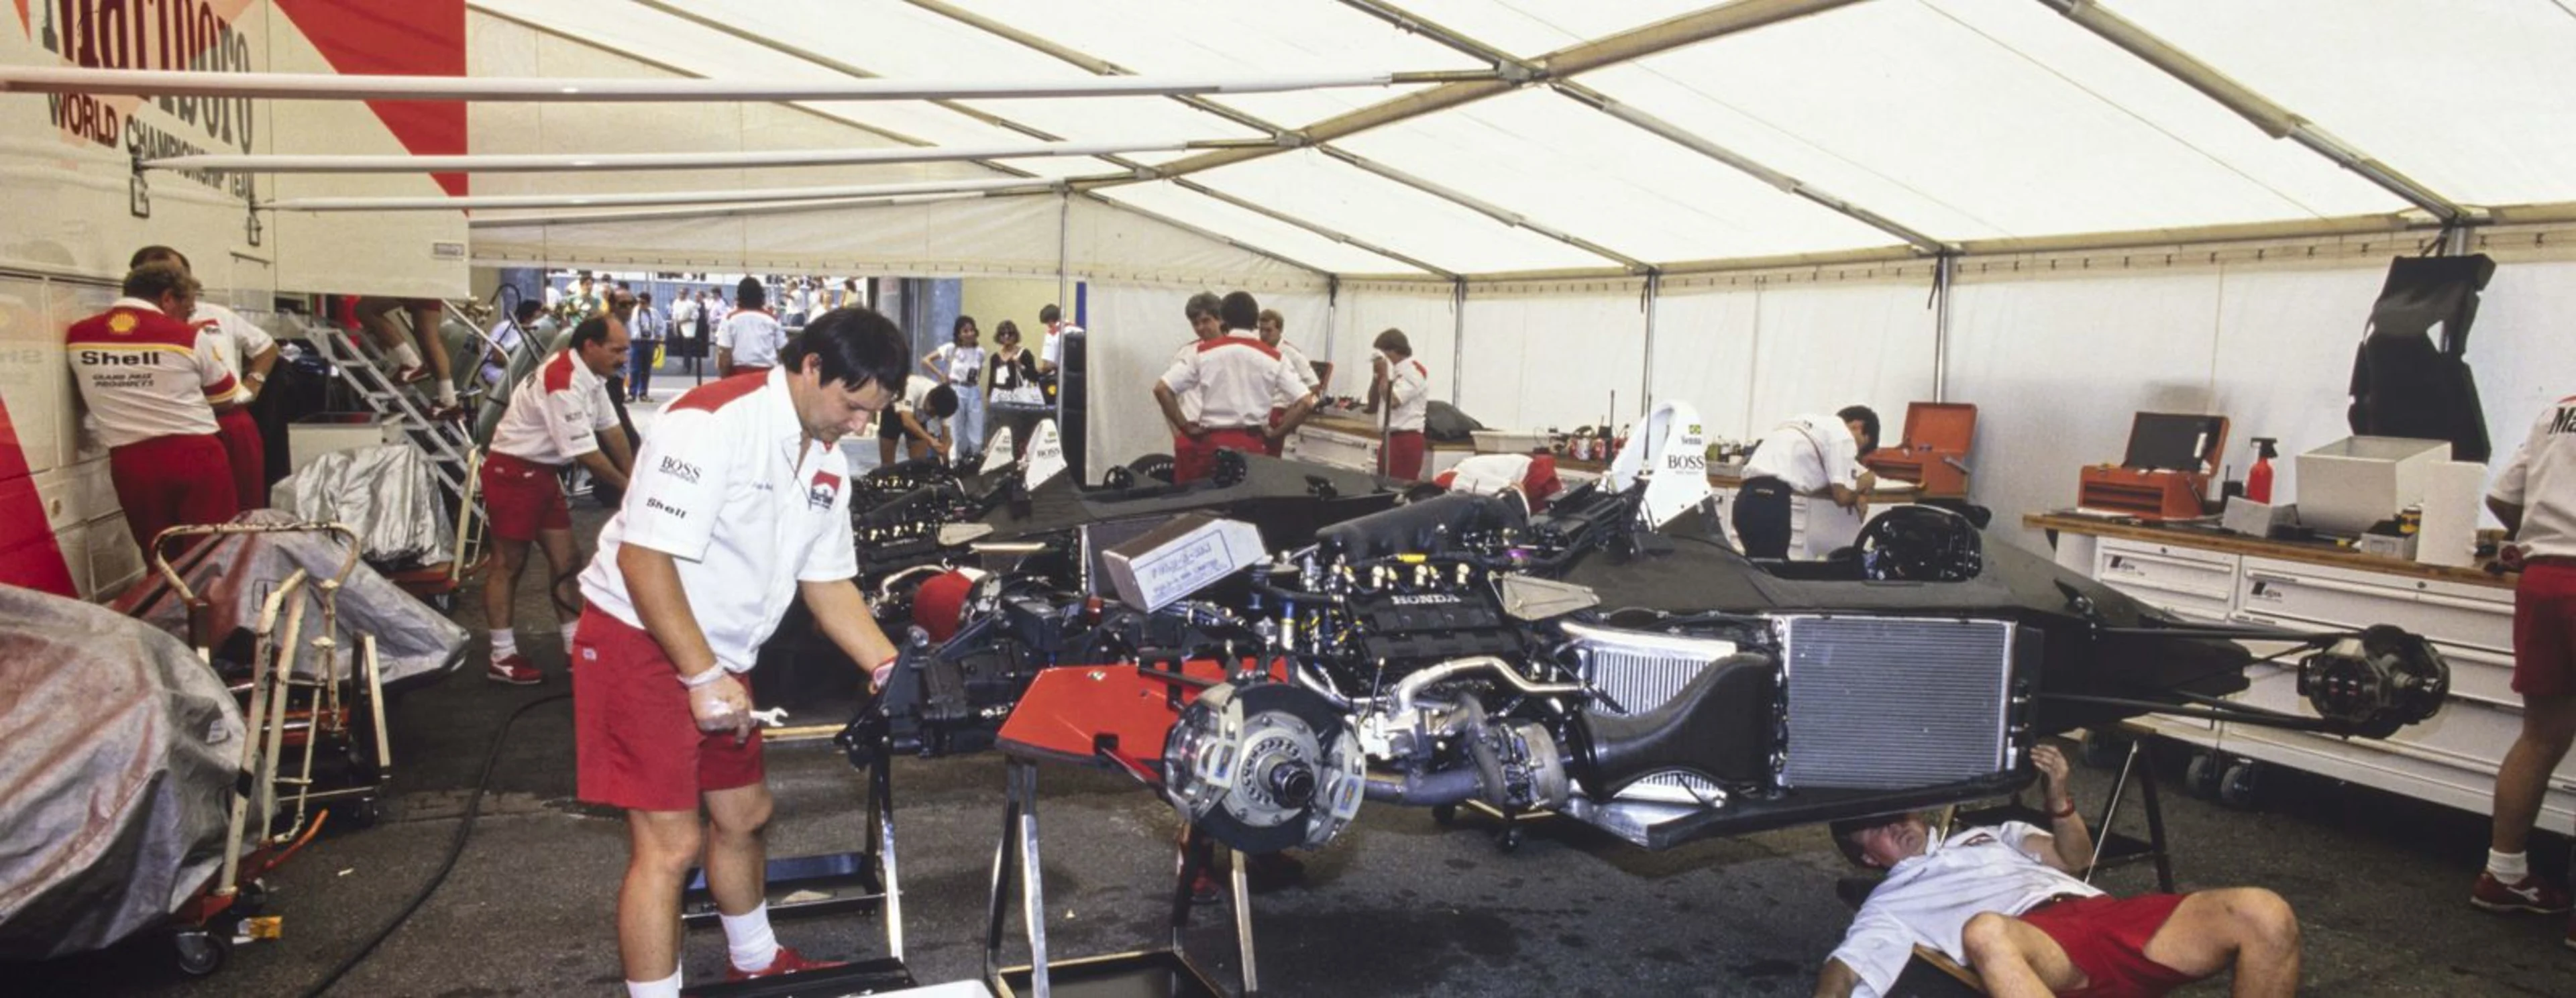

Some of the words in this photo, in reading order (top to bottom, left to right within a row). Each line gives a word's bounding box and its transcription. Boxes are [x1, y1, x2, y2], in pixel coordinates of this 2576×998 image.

[48, 92, 119, 149] WORLD
[81, 351, 160, 365] Shell
[661, 456, 702, 479] BOSS
[1667, 455, 1704, 469] BOSS
[647, 497, 686, 519] Shell
[1391, 594, 1462, 604] HONDA
